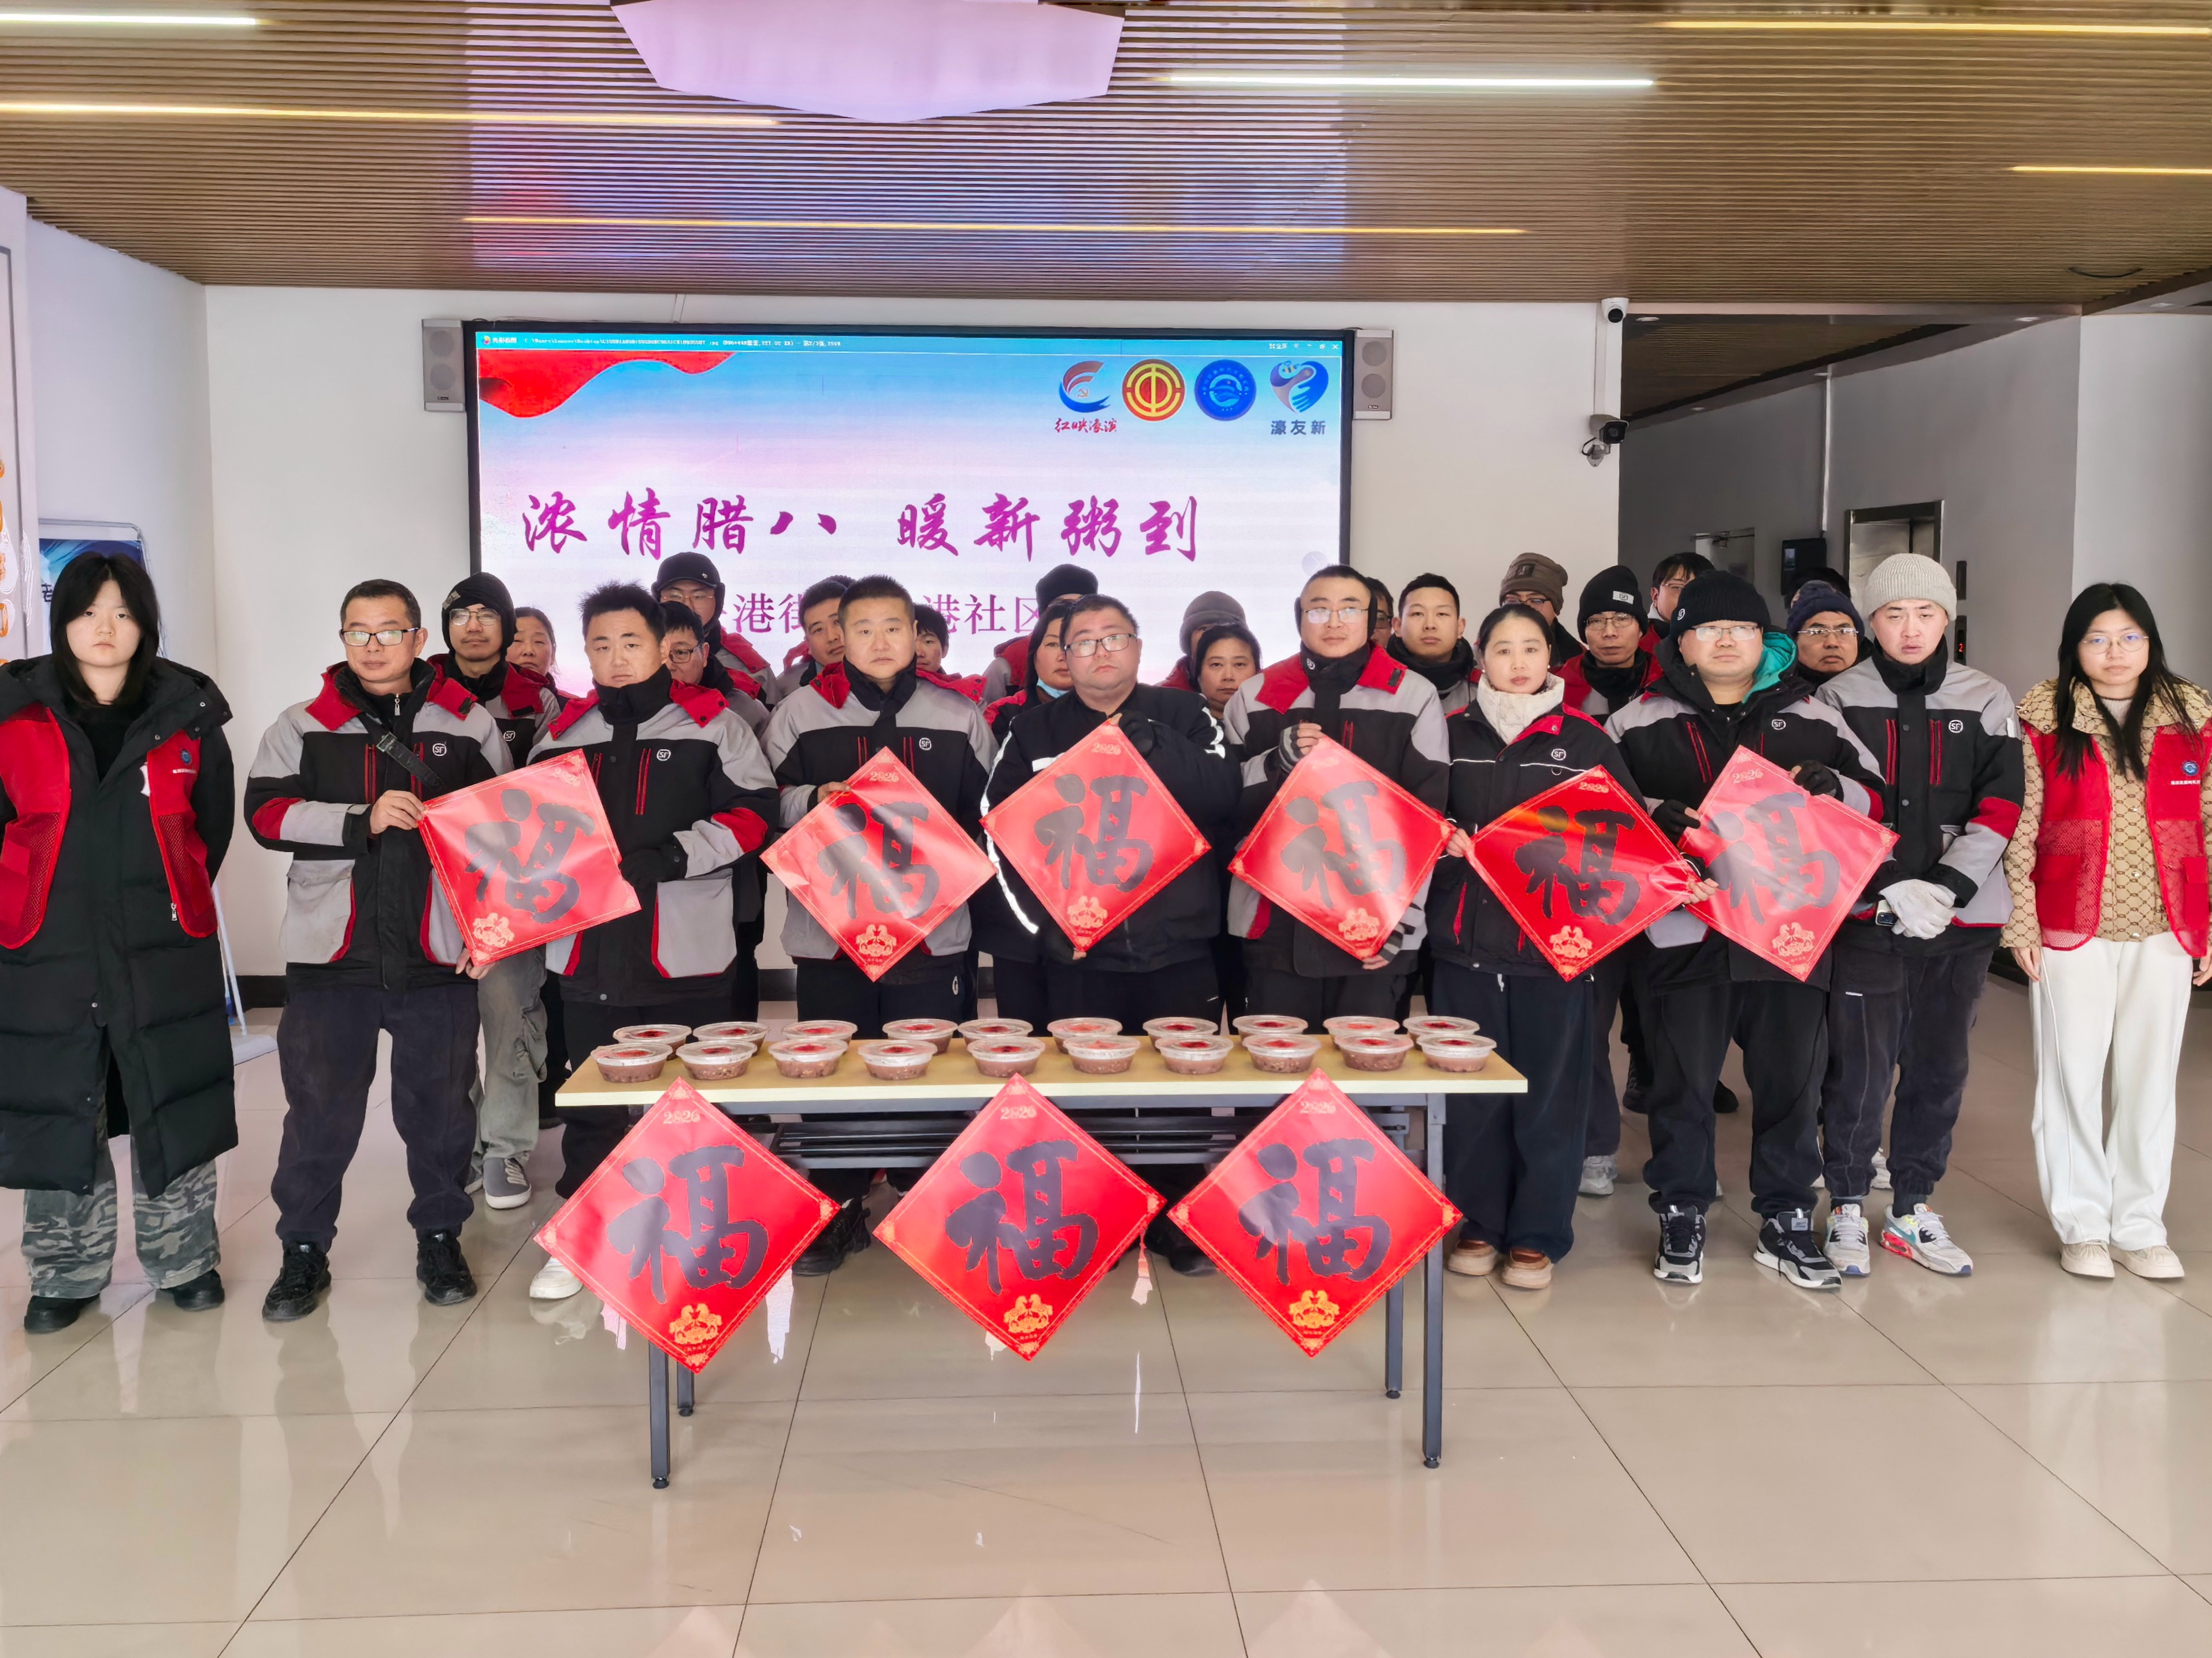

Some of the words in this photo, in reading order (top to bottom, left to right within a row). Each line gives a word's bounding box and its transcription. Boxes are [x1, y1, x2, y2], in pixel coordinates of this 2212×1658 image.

[522, 488, 836, 560] 浓情腊八
[898, 493, 1197, 561] 暖新粥到
[1958, 643, 1964, 652] 2
[465, 788, 595, 924] 福
[817, 801, 940, 919] 福
[1034, 774, 1153, 892] 福
[1279, 780, 1406, 908] 福
[1514, 806, 1641, 925] 福
[1707, 791, 1840, 925] 福
[607, 1145, 769, 1304] 福
[945, 1139, 1099, 1295] 福
[1238, 1139, 1391, 1285] 福
